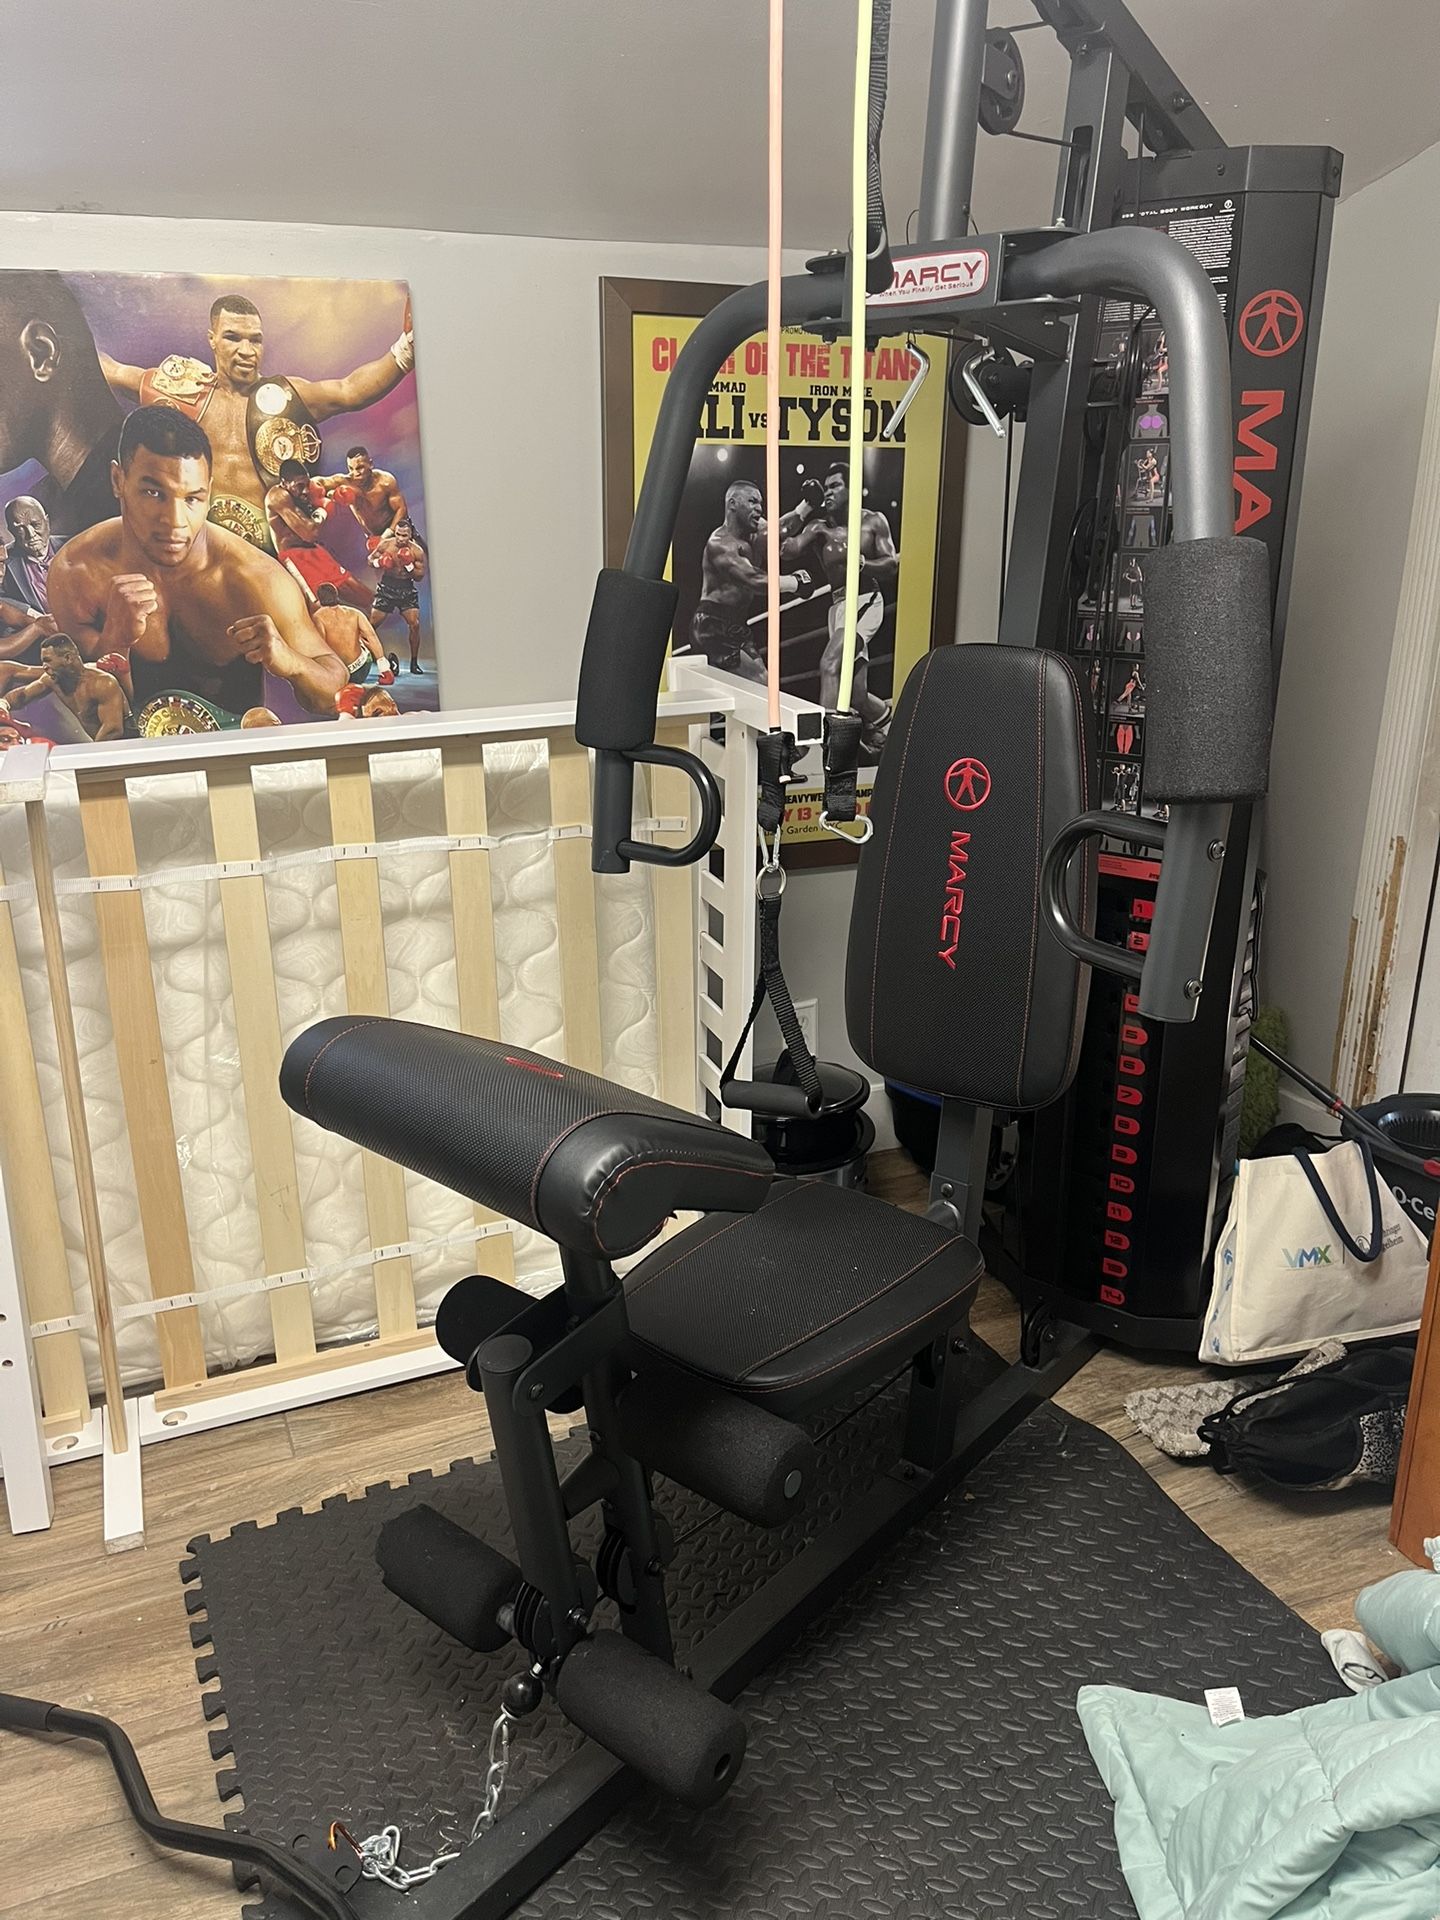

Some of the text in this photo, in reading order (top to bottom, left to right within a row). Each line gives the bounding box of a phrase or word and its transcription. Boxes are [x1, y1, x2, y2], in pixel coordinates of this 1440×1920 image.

[893, 260, 982, 288] ARCY
[786, 344, 830, 378] THE
[709, 382, 746, 393] MMAD
[810, 385, 873, 397] IRON ME
[699, 394, 745, 439] LI
[778, 397, 906, 442] TYSON
[786, 825, 818, 835] Garden
[938, 831, 971, 969] MARCY
[1133, 935, 1144, 946] 2
[1282, 1244, 1332, 1268] VMX
